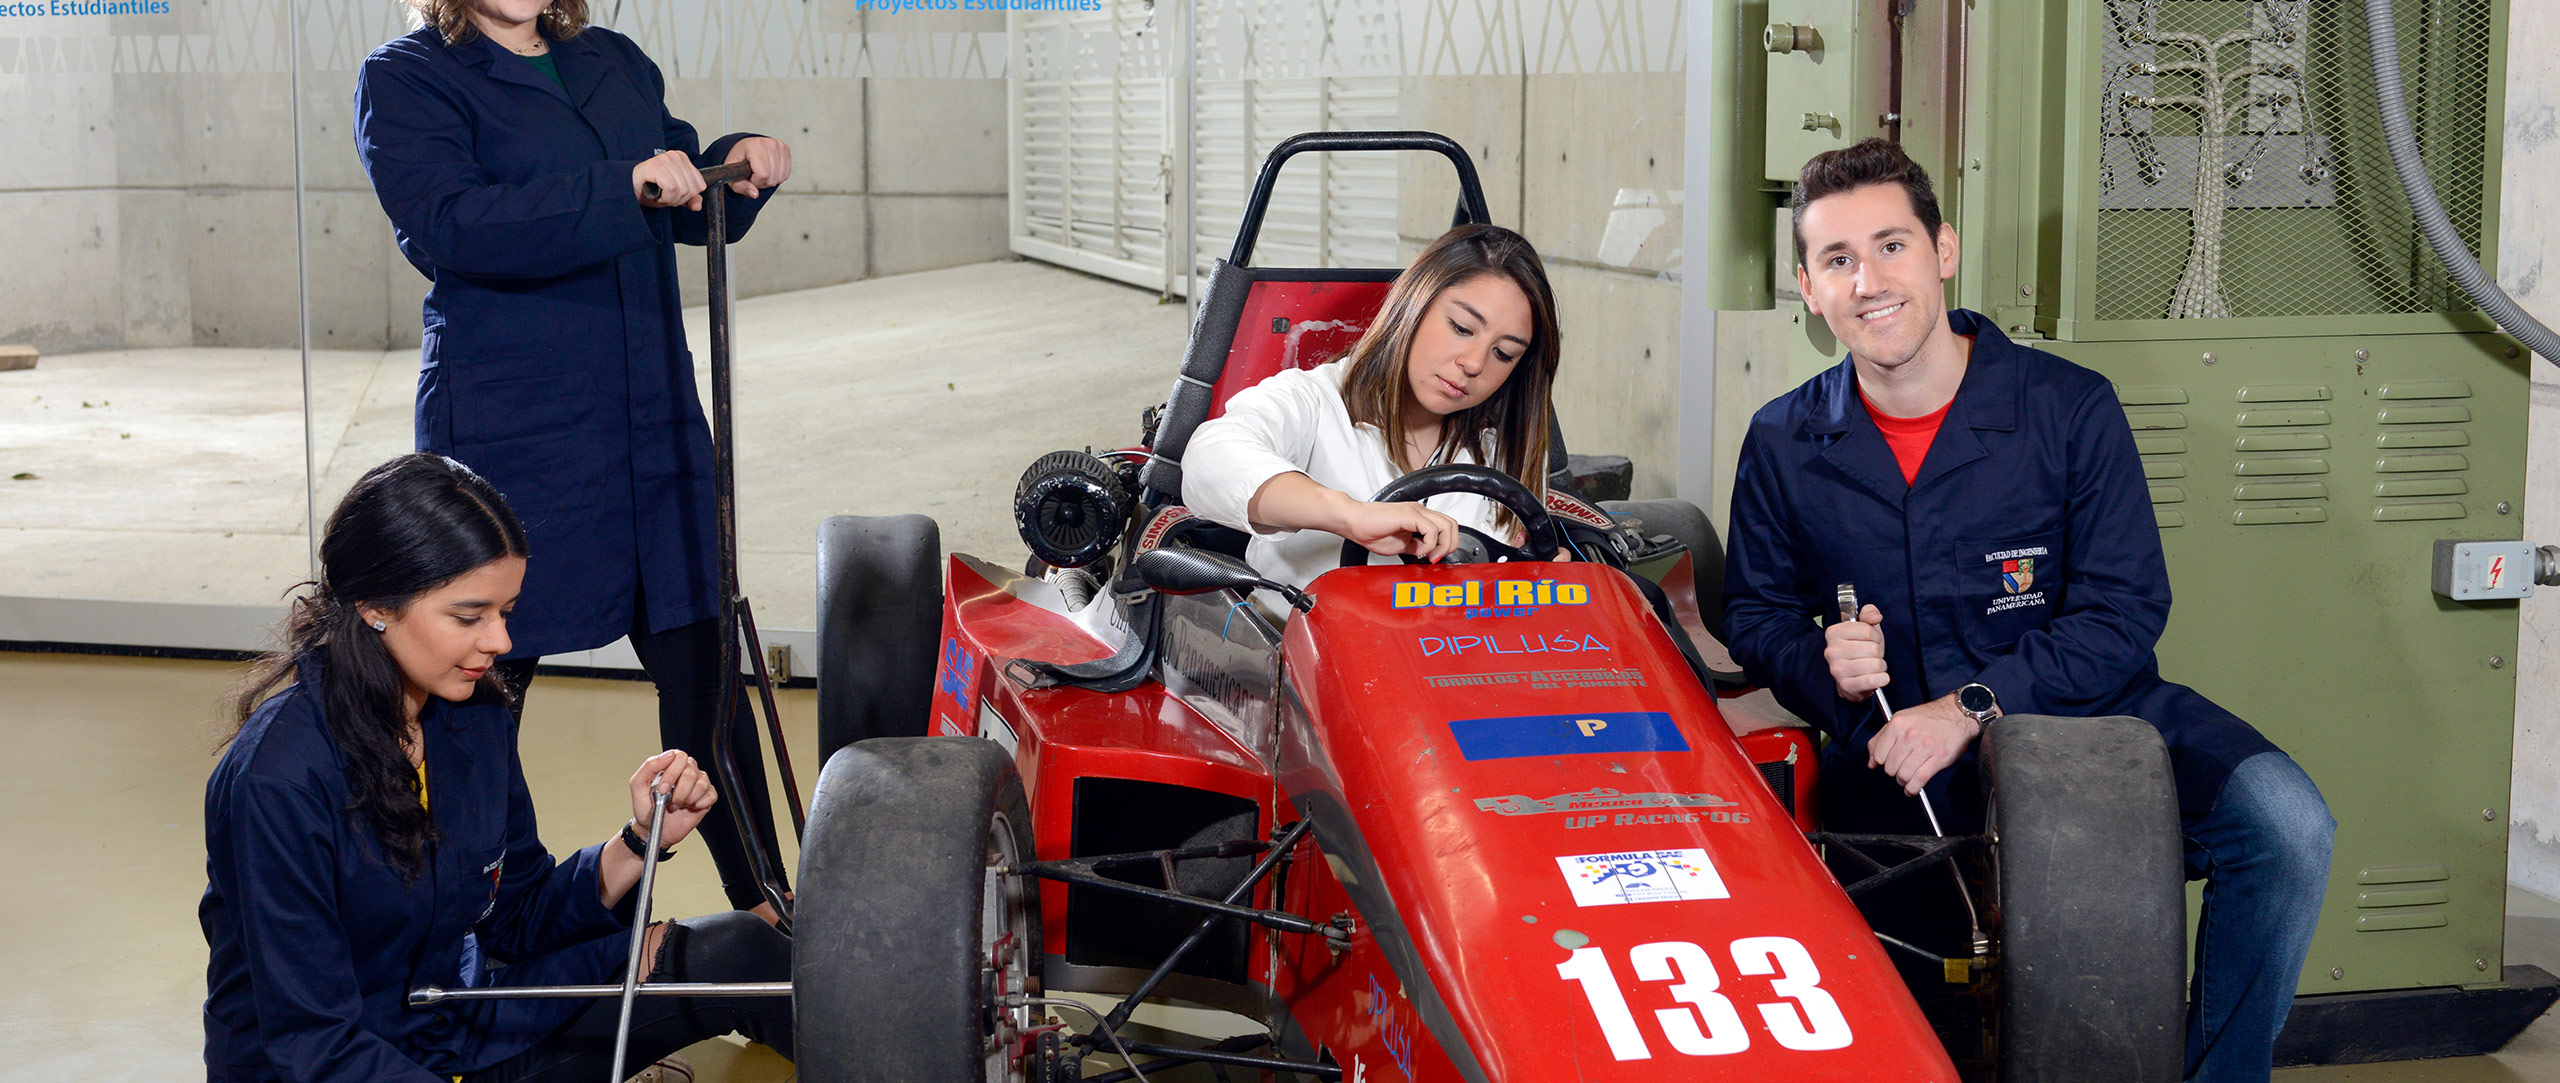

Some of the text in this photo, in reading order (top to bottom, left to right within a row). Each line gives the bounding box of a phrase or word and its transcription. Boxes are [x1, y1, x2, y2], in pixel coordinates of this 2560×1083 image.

[0, 0, 170, 17] ectos Estudiantiles
[855, 0, 1102, 15] Proyectos Estudiantiles
[1546, 496, 1606, 524] SIMPSO
[1392, 579, 1590, 609] Del Río
[1992, 591, 2043, 606] UNIVERSIDAD
[1465, 606, 1539, 620] power
[1986, 598, 2045, 615] PANAMERICANA
[1418, 634, 1611, 656] DIPILUSA
[1423, 671, 1520, 688] TORNILLOS
[1566, 679, 1649, 689] PONIENTE
[1565, 815, 1608, 830] UP
[1579, 850, 1683, 864] FORMULA SAE
[1555, 936, 1854, 1062] 133
